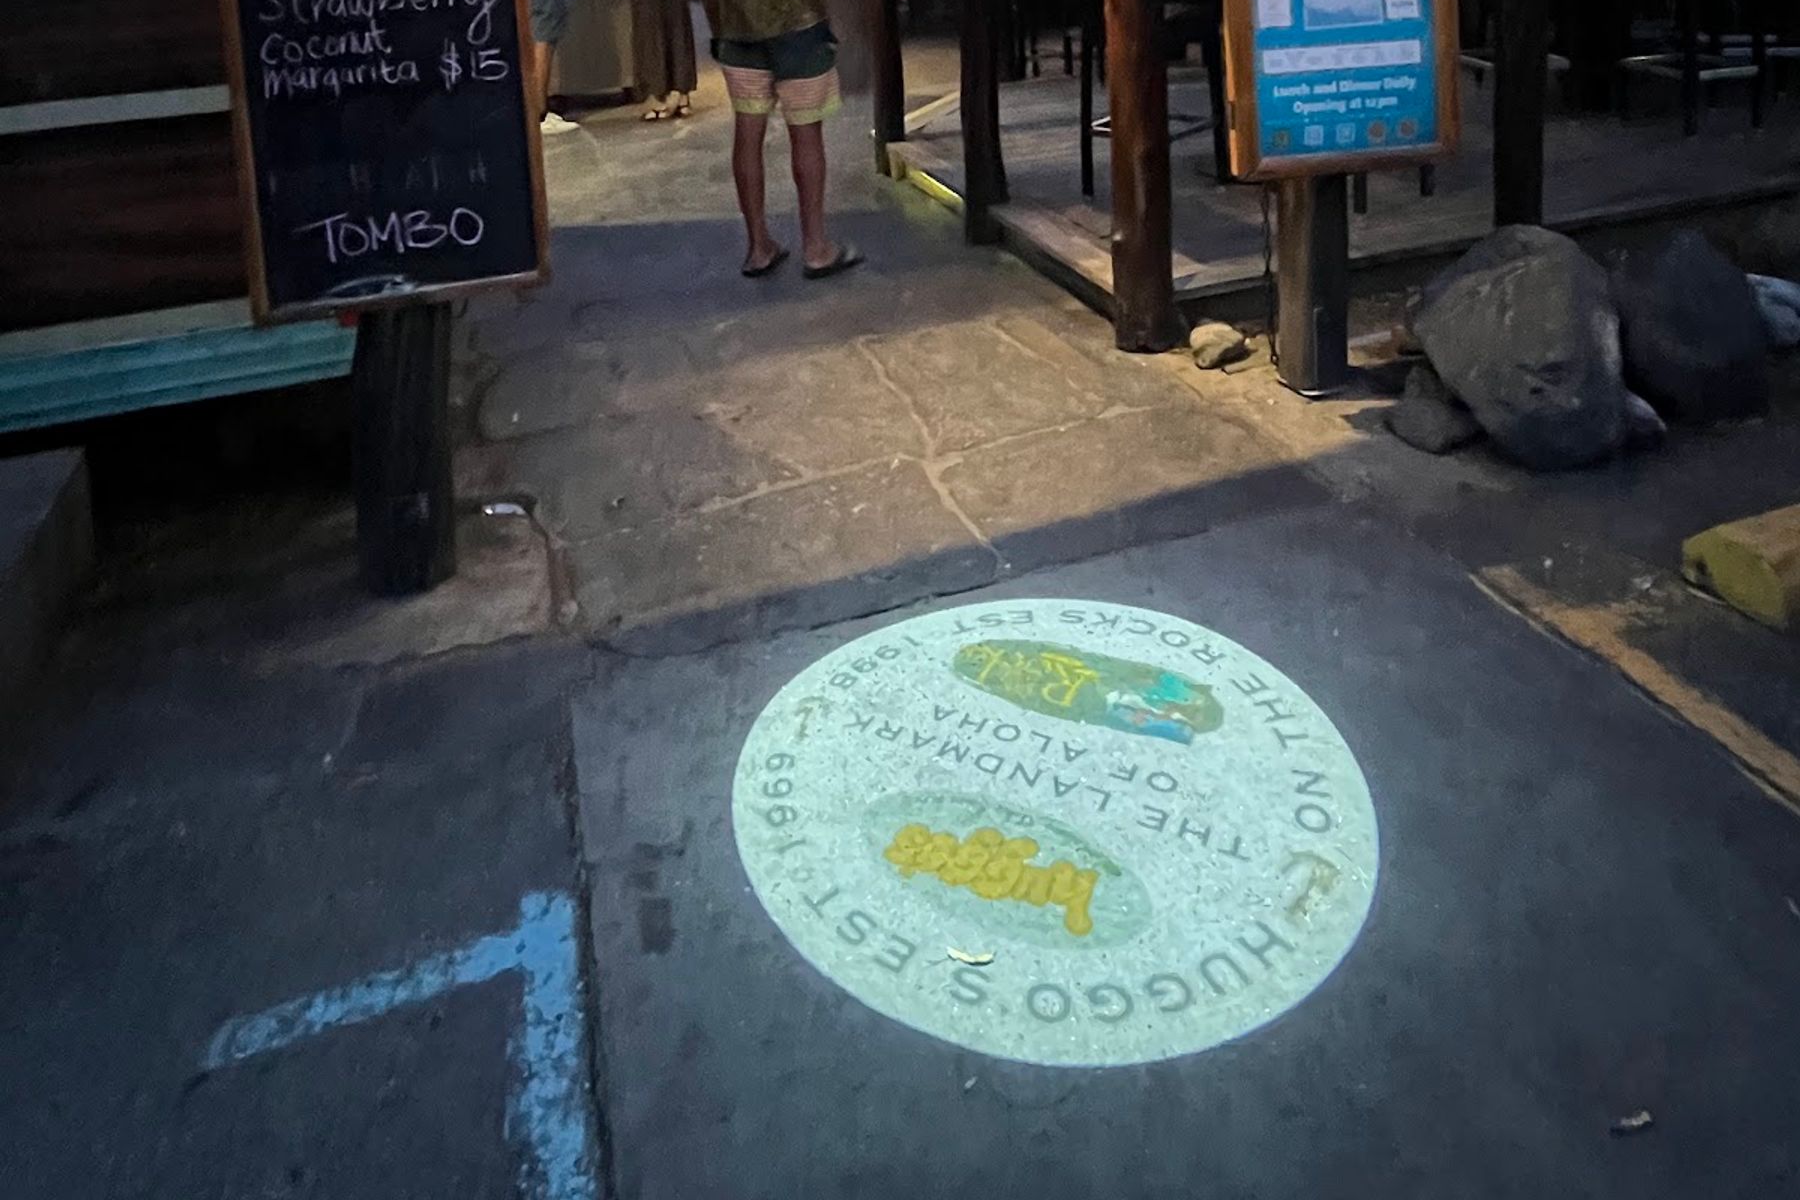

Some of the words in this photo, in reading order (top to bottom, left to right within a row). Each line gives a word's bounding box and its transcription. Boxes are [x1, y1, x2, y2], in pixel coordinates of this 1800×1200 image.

[438, 38, 509, 90] $15
[292, 206, 485, 264] TOMBO
[1060, 608, 1225, 666] ROCKS
[933, 704, 1089, 763] ALOHA
[1229, 671, 1311, 750] THE
[843, 711, 1112, 813] LANDMARK
[1108, 762, 1178, 794] OF
[762, 751, 808, 856] 1969
[1292, 769, 1333, 834] ON
[1136, 804, 1251, 862] THE
